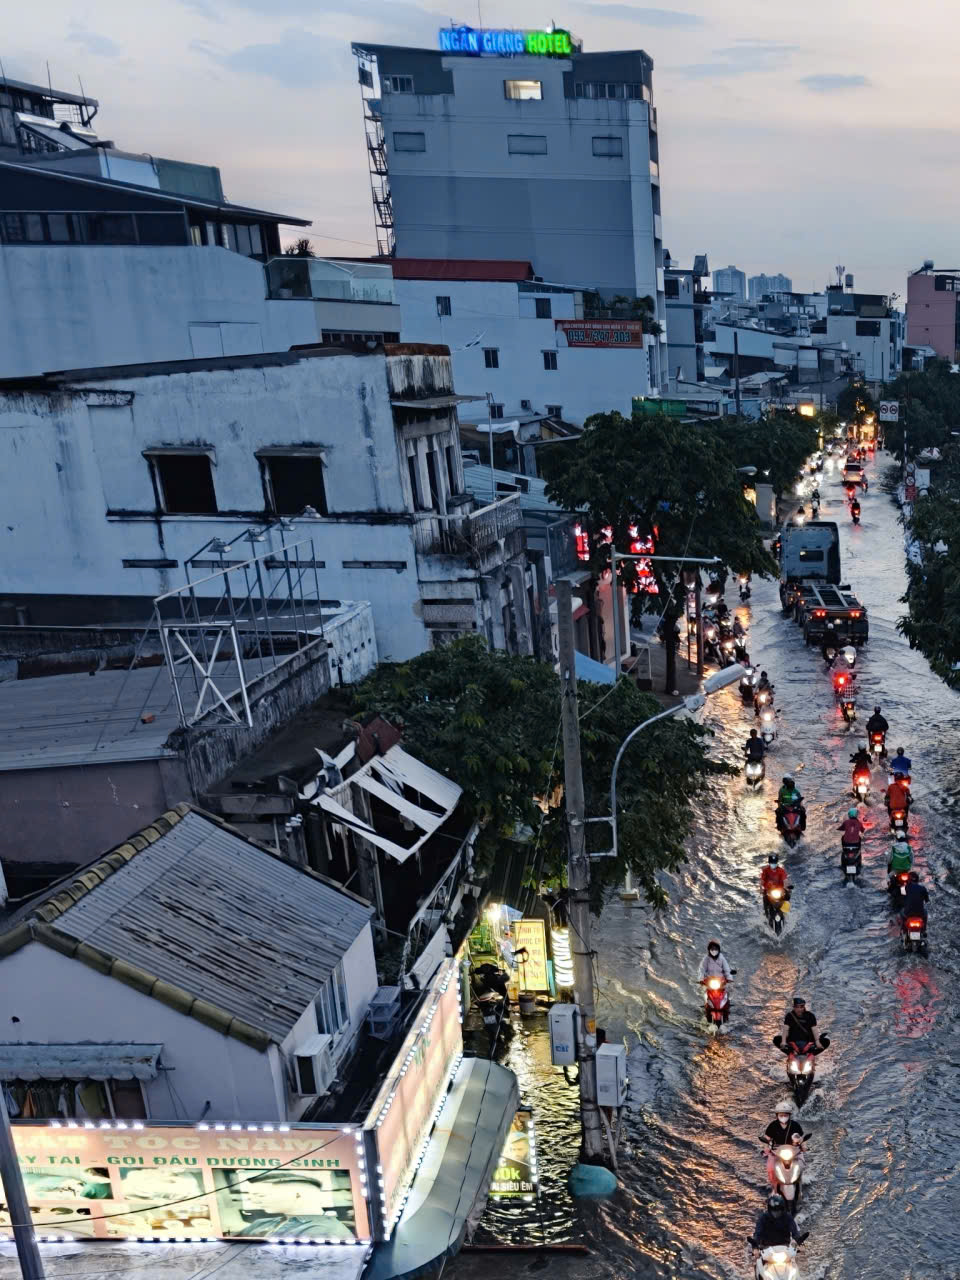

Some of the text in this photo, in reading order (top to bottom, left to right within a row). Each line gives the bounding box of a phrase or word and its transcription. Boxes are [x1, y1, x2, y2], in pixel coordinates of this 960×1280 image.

[483, 31, 524, 53] GIANG
[527, 33, 571, 54] HOTEL
[217, 1136, 326, 1152] NAM
[290, 1158, 341, 1168] SINH
